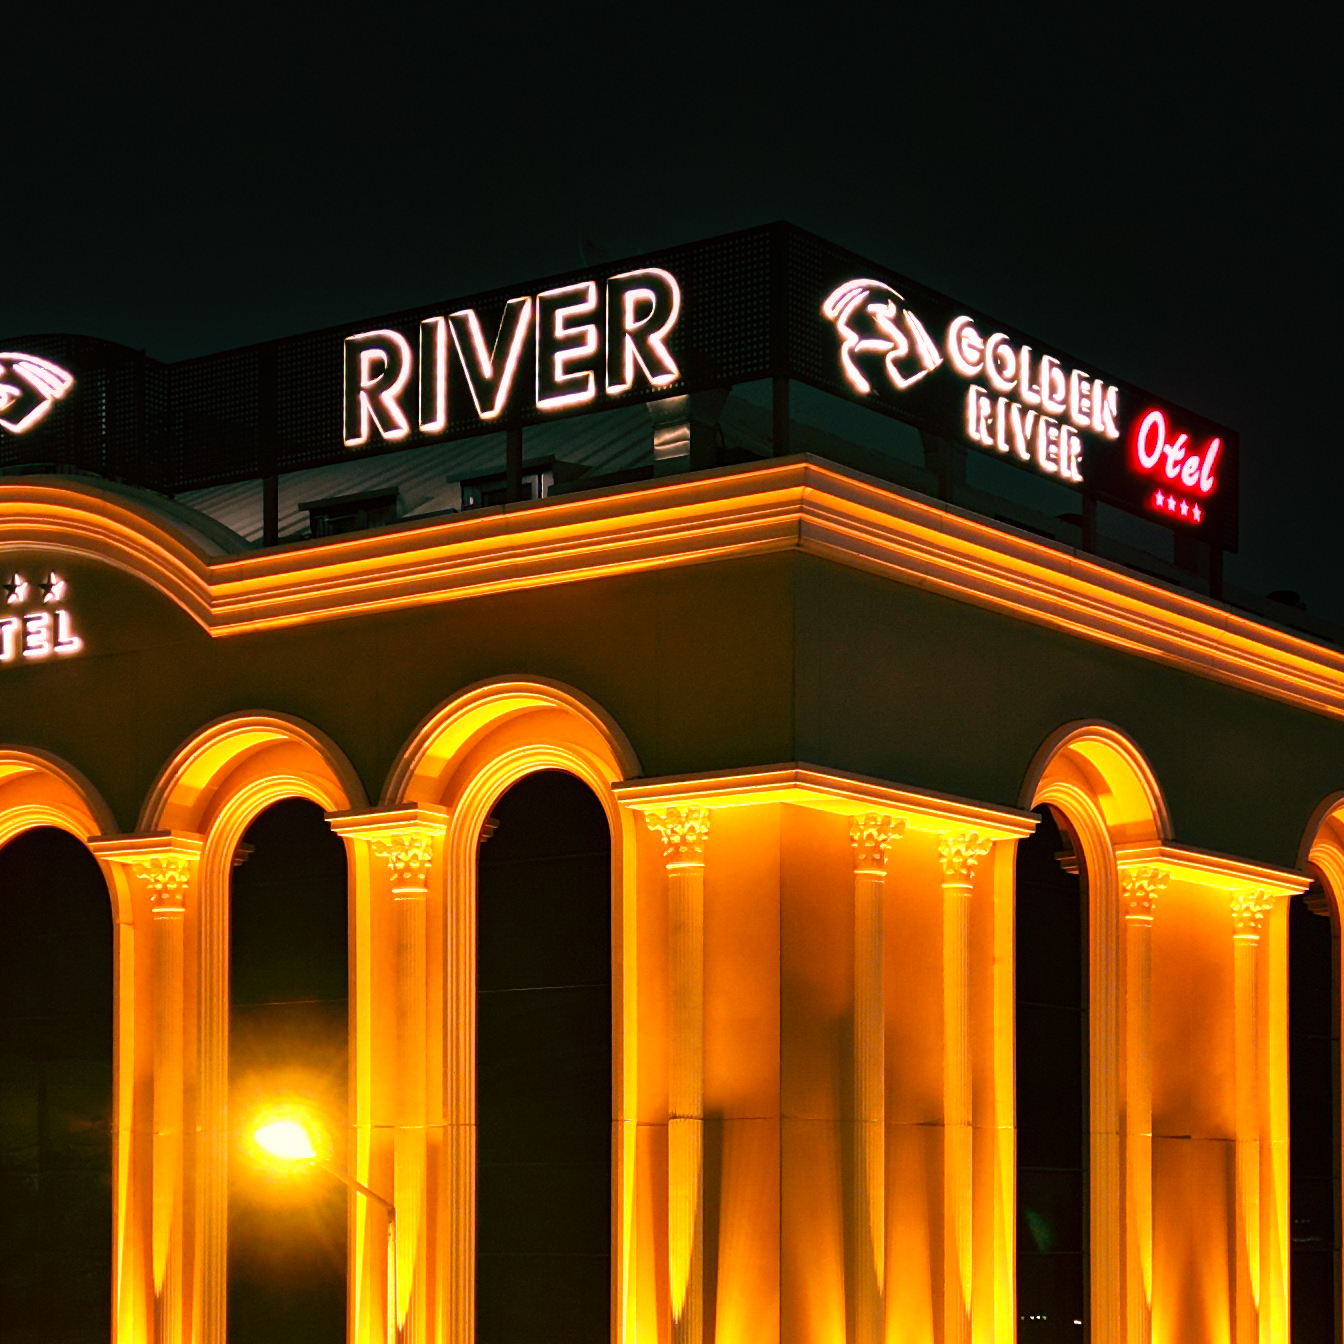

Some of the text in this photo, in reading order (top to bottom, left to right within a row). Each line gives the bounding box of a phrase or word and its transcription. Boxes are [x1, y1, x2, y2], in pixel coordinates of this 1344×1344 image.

[343, 266, 682, 447] RIVER
[946, 314, 1120, 439] GOLDEN
[964, 383, 1085, 483] RIVER
[1136, 409, 1222, 493] Otel
